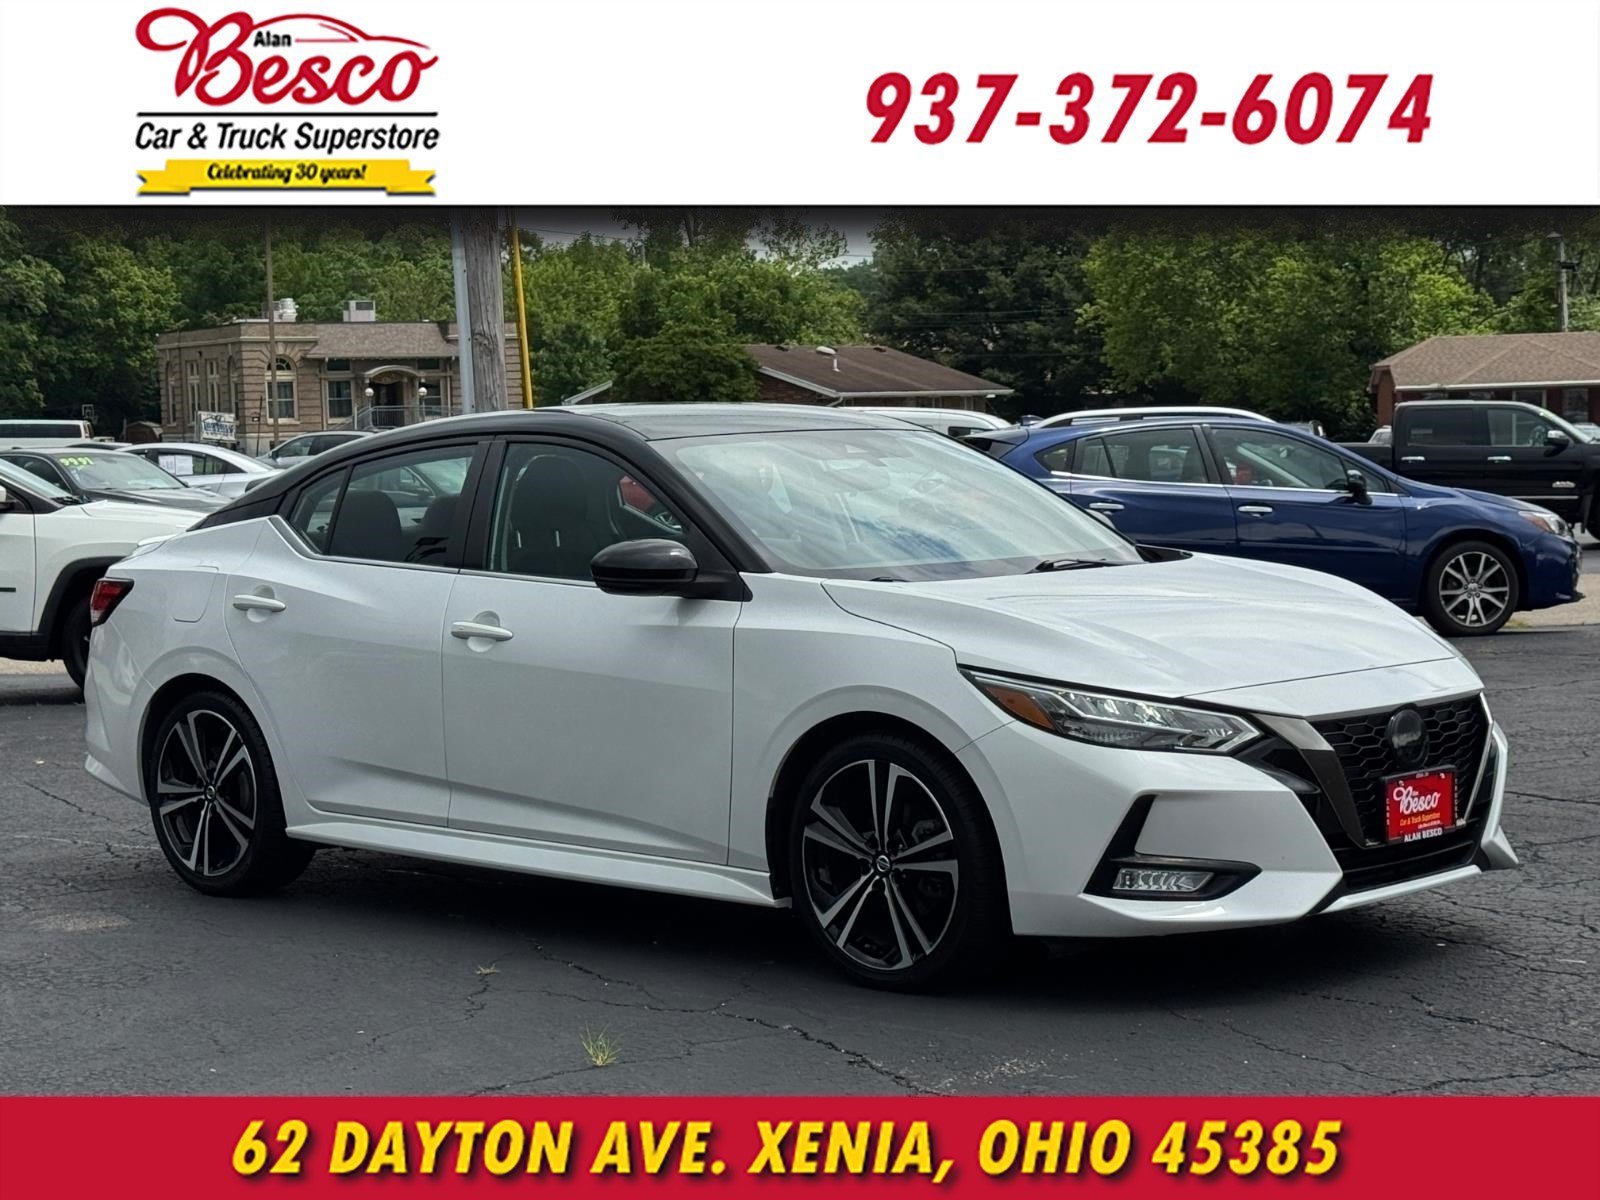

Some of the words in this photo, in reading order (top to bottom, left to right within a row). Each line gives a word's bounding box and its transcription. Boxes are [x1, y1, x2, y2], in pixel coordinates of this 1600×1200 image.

[1393, 785, 1441, 815] Besco
[1404, 831, 1421, 843] ALAN
[1422, 827, 1443, 839] BESCO
